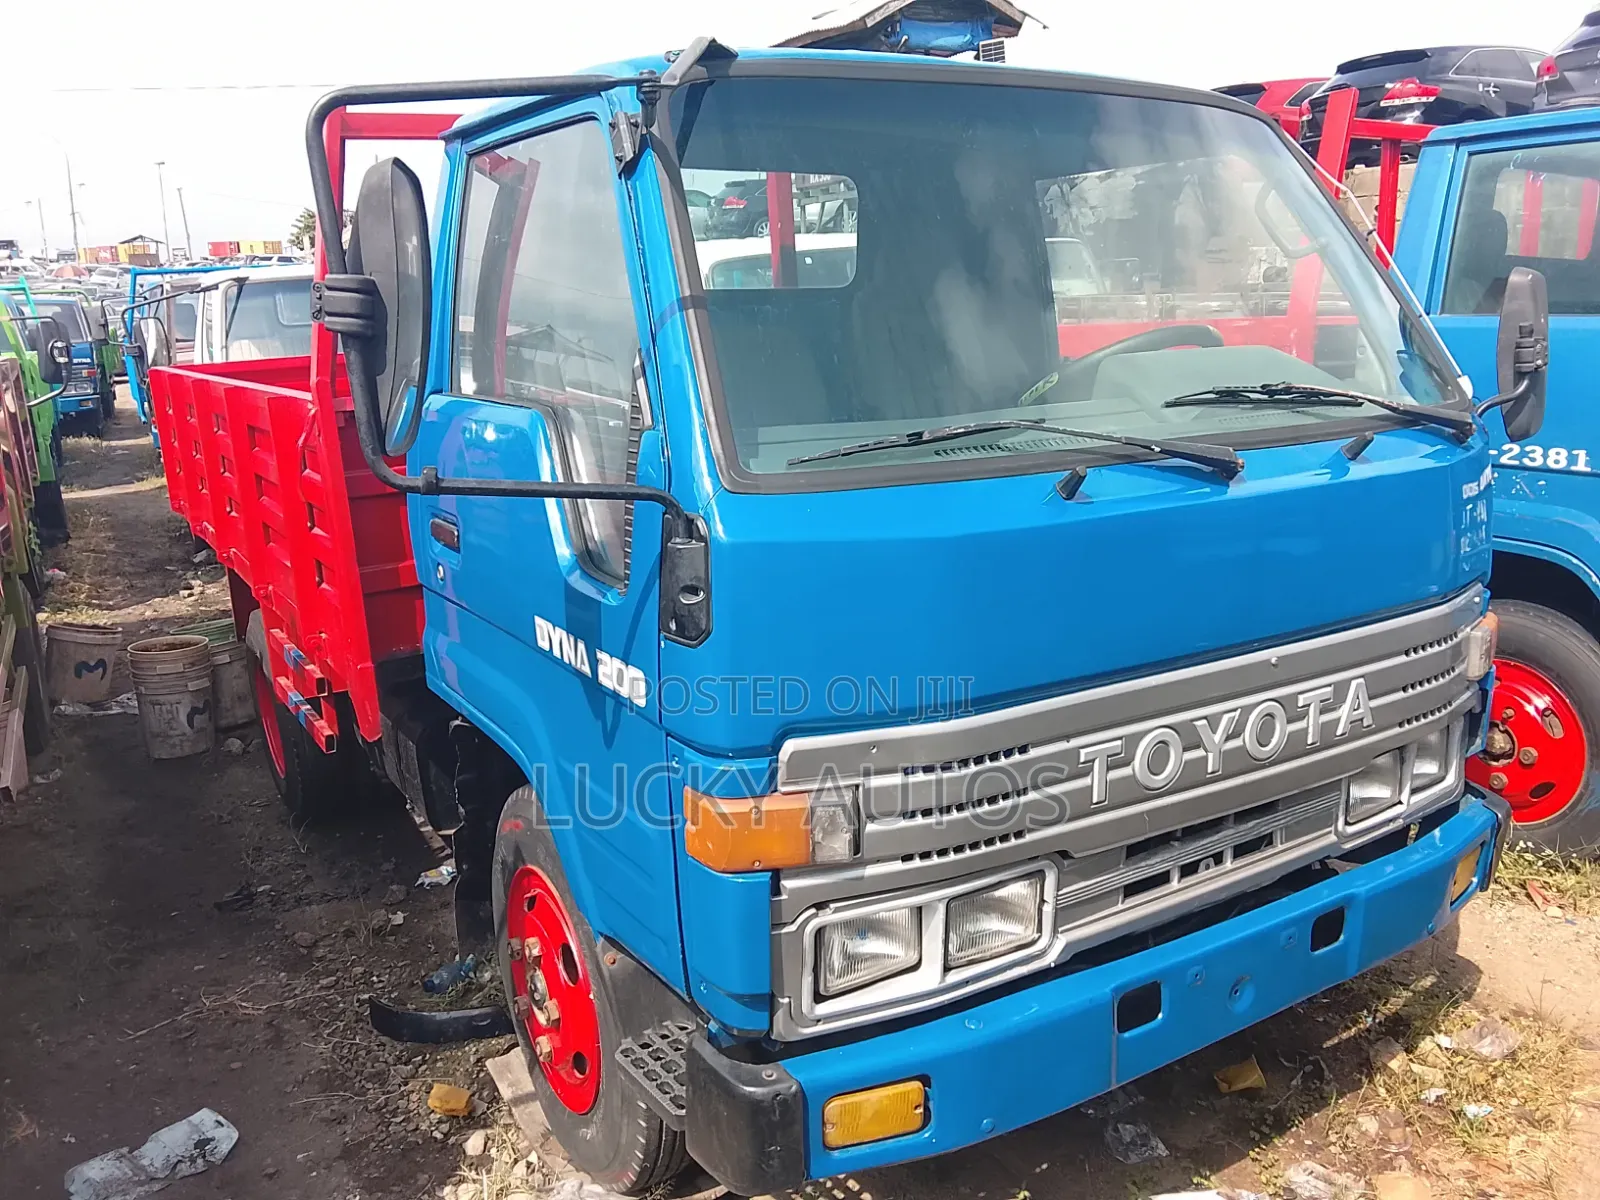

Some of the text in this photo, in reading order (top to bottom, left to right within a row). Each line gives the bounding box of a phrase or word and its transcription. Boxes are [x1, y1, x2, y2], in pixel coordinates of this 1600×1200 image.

[533, 614, 647, 708] DYNA 200
[1078, 676, 1376, 808] TOYOTA
